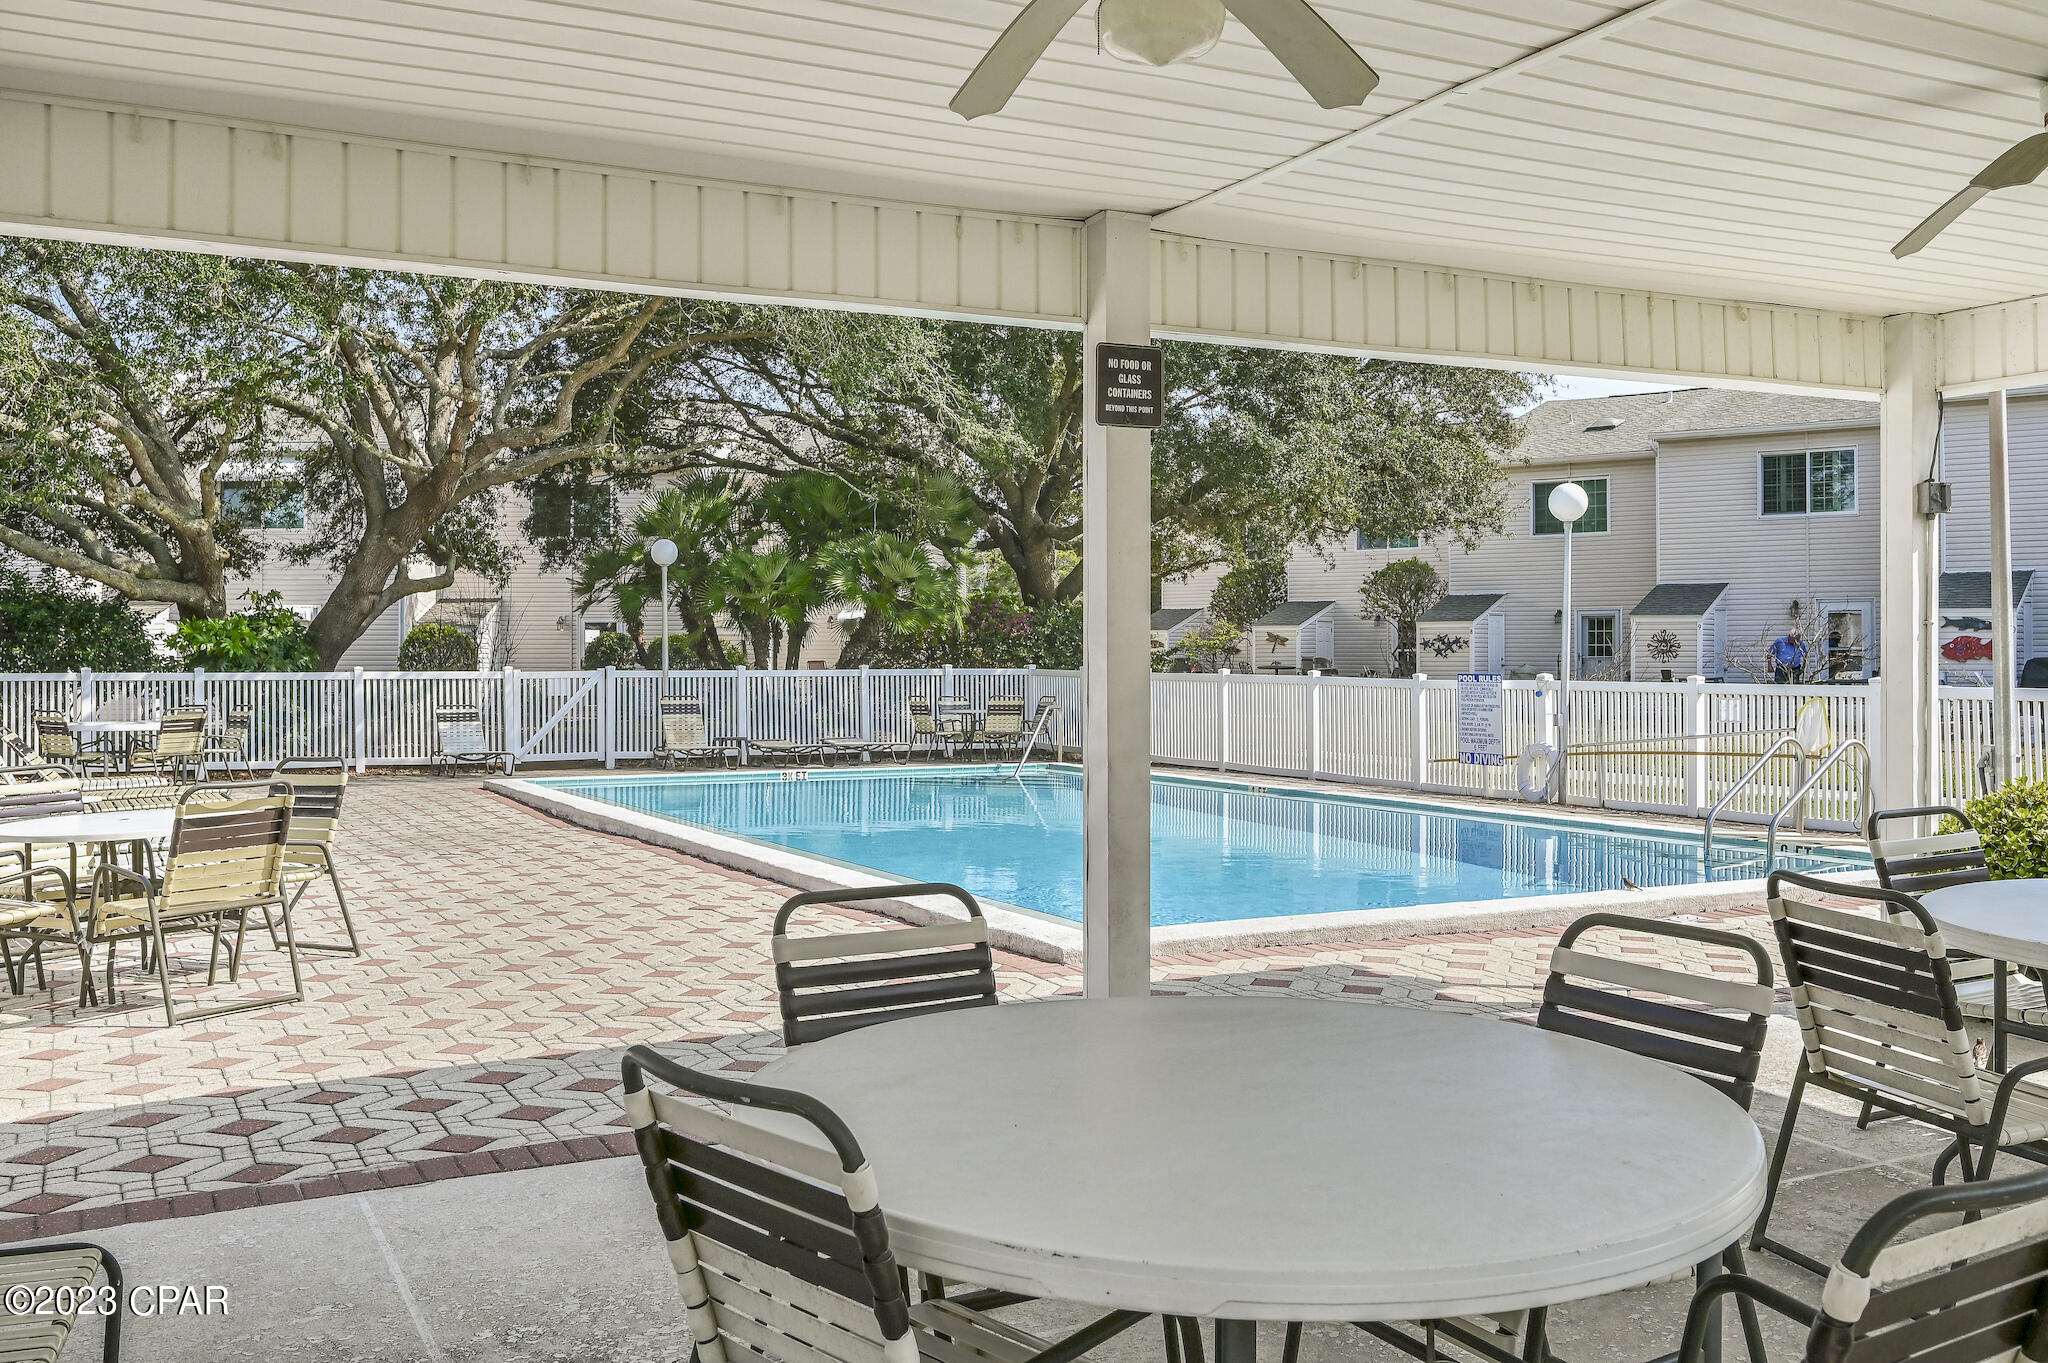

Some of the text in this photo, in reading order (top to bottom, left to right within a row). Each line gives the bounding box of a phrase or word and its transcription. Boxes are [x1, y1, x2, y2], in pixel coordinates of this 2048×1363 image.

[1108, 358, 1152, 371] NO FOOD OR
[1118, 373, 1142, 384] GLASS
[1107, 387, 1152, 399] CONTAINERS
[1106, 404, 1126, 412] BEYOND
[1138, 406, 1154, 414] POINT
[1479, 675, 1502, 683] RULES
[1460, 752, 1503, 766] NO DIVING
